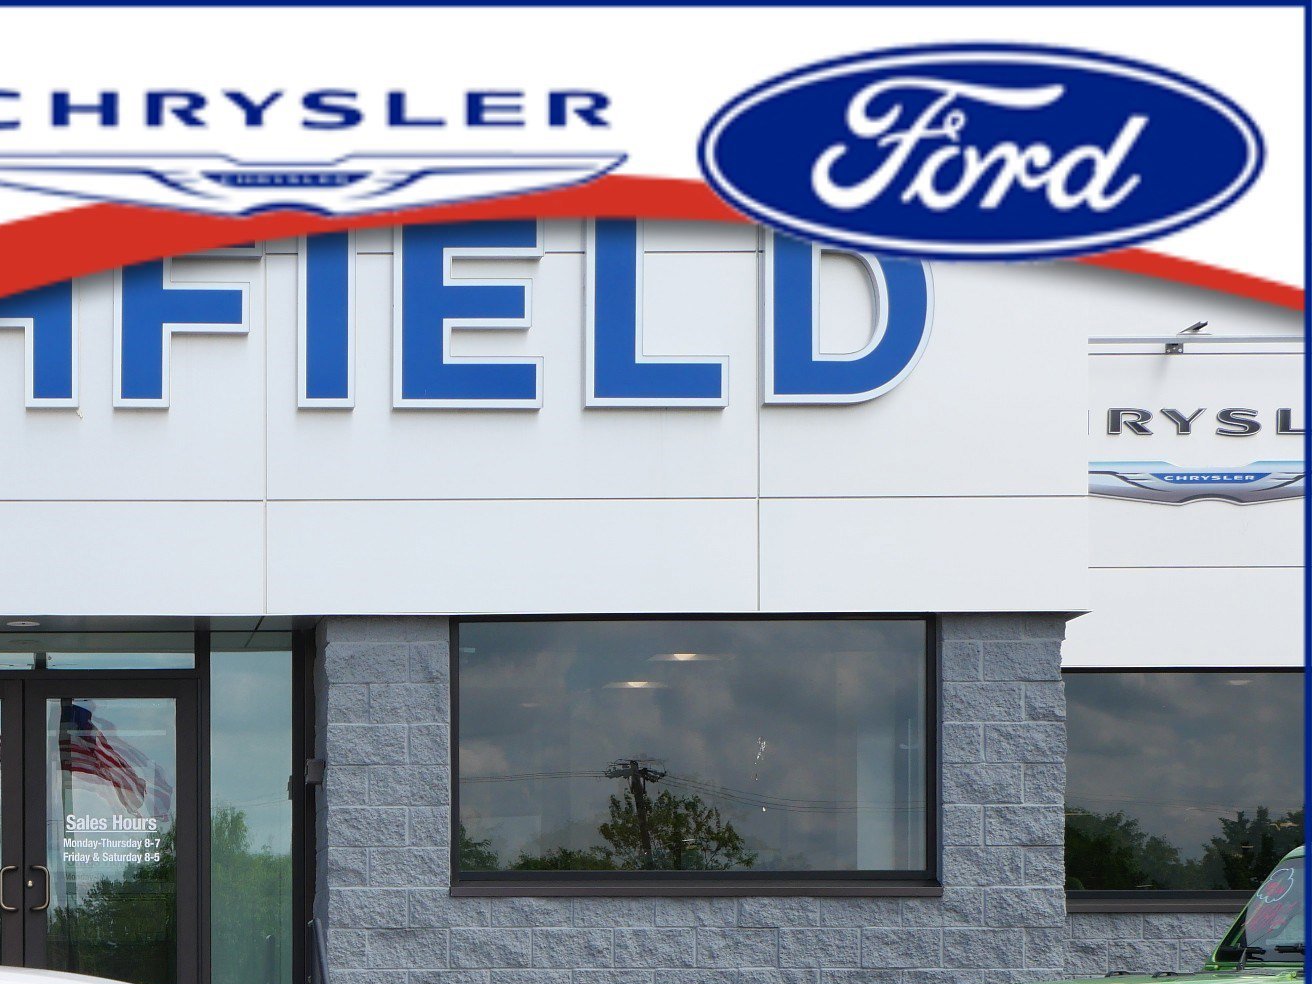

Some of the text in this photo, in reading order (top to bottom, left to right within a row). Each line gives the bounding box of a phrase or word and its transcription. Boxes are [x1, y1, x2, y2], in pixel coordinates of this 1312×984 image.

[1088, 407, 1306, 436] RYSL
[1163, 474, 1255, 482] CHRYSLER
[66, 814, 157, 831] Sales Hours
[63, 838, 161, 849] Monday-Thursday 8-7
[63, 852, 160, 863] Friday & Saturday 8-5
